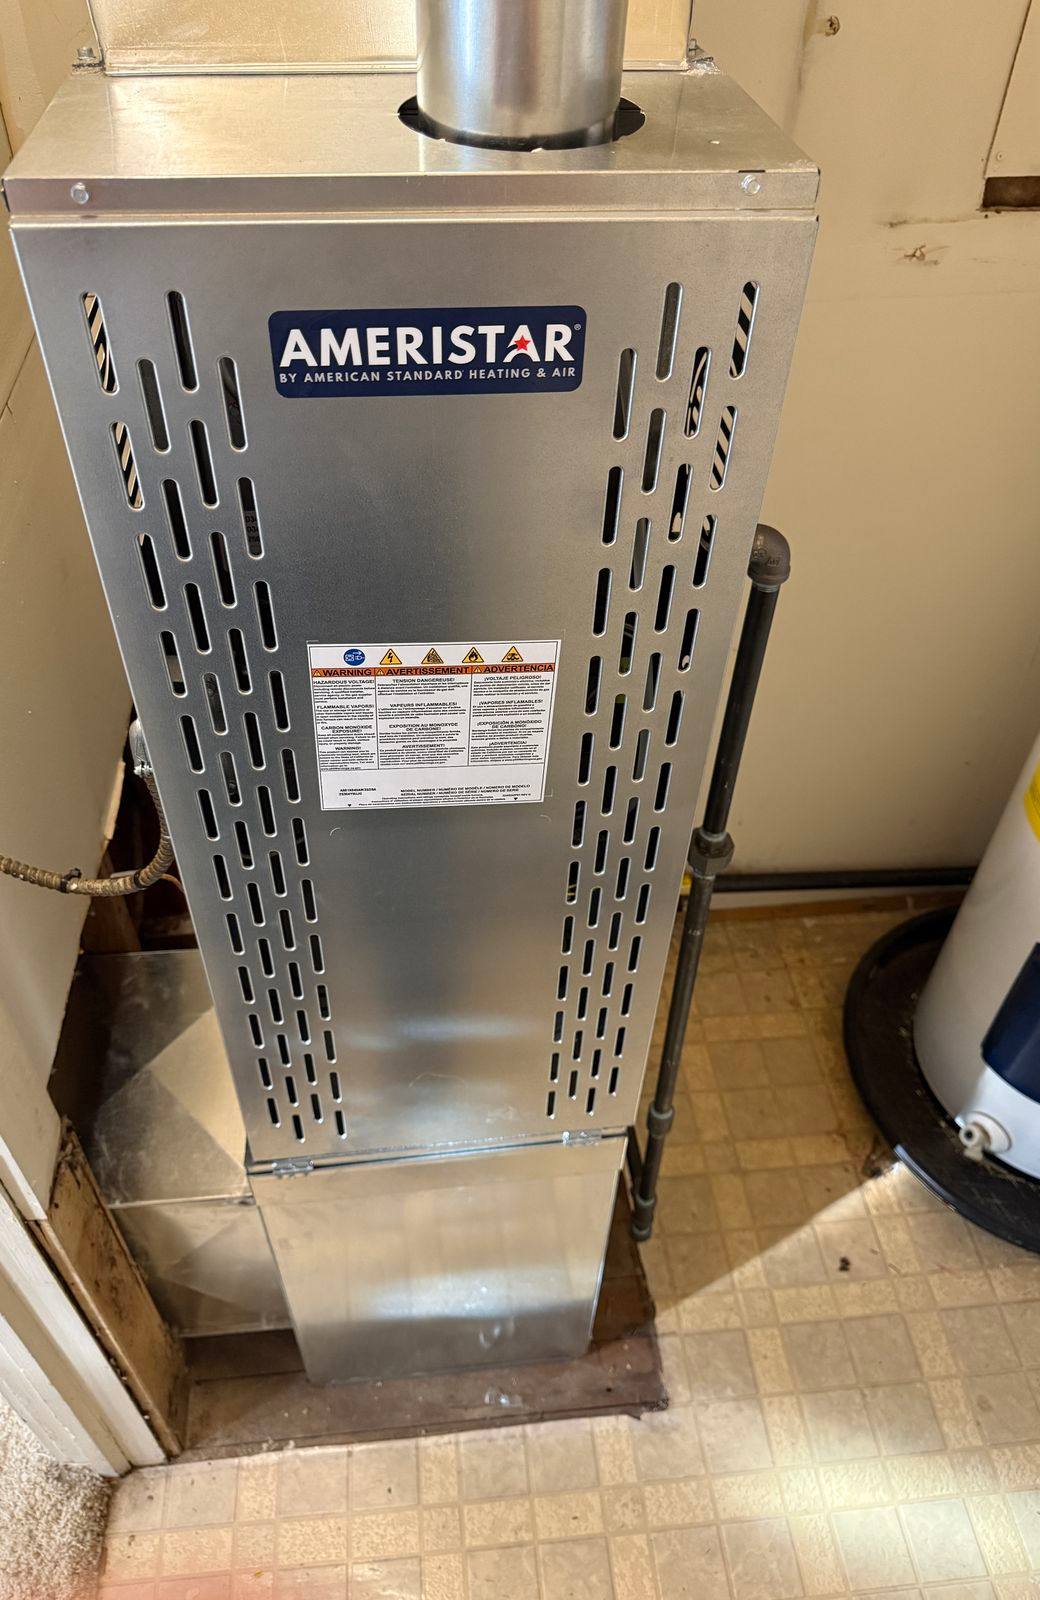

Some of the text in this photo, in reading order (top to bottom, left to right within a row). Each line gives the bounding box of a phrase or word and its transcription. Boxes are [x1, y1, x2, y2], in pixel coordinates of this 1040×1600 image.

[279, 367, 576, 384] BY AMERICAN STANDARD HEATING & AIR
[322, 668, 372, 677] WARNING
[386, 666, 469, 676] AVERTISSEMENT
[483, 664, 554, 673] ADVERTENCIA
